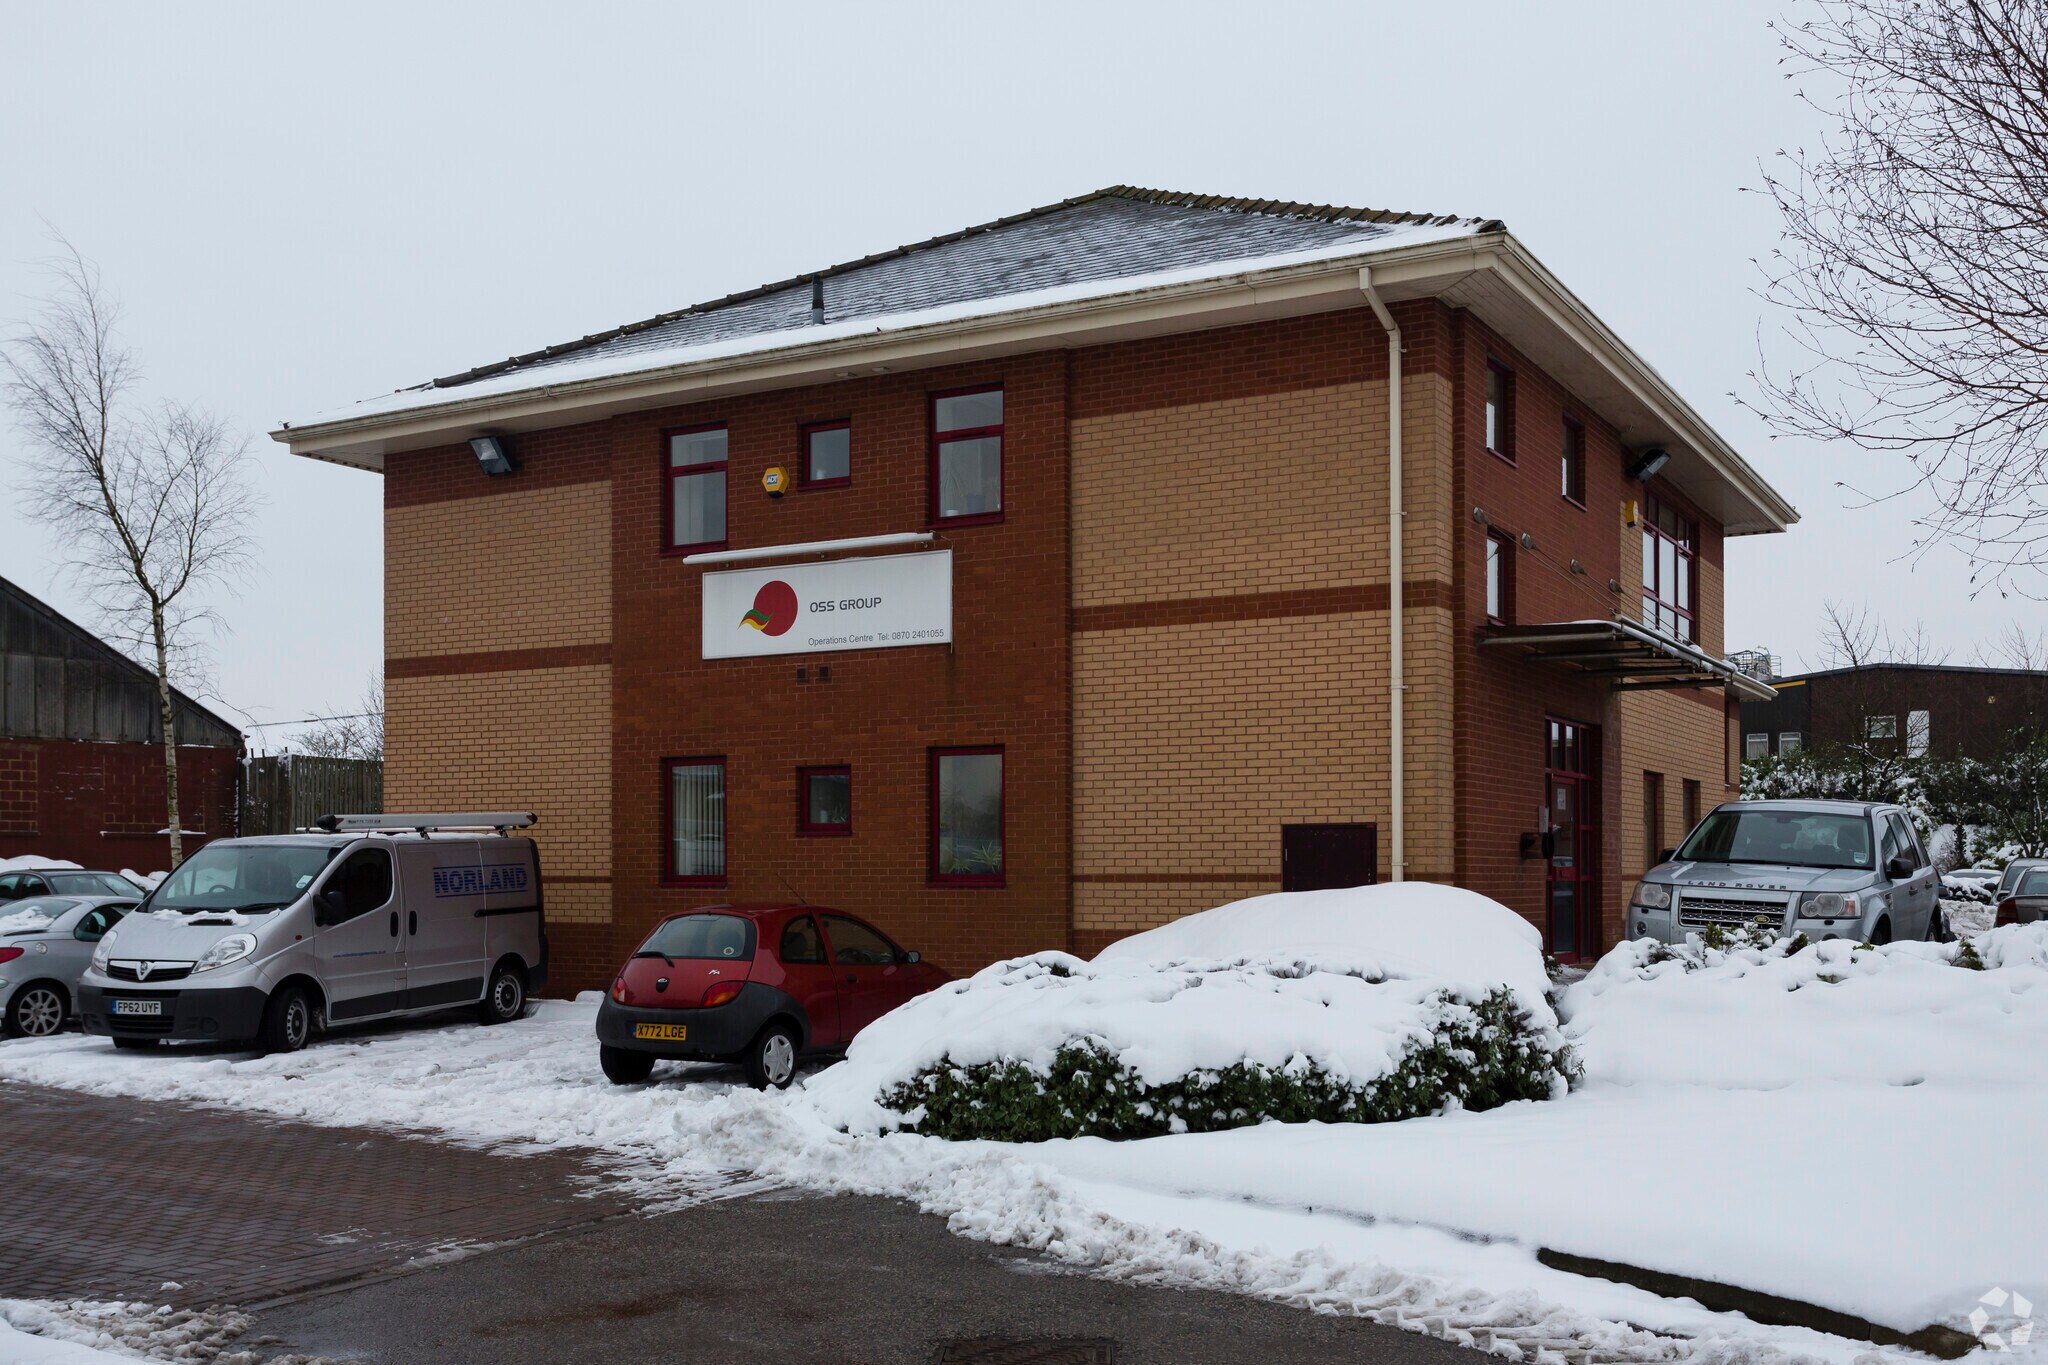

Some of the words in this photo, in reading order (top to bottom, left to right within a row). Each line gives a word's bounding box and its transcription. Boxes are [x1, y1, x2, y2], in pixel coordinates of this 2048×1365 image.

[809, 600, 835, 613] OSS
[839, 597, 882, 611] GROUP
[808, 635, 847, 647] Operations
[849, 634, 873, 643] Centre
[877, 632, 890, 641] Tel:
[892, 631, 910, 640] 0870
[912, 629, 944, 639] 2401055
[433, 867, 528, 894] NORLAND
[117, 1002, 140, 1013] FP62
[141, 1002, 160, 1013] UYF
[637, 1024, 662, 1037] X772
[664, 1026, 685, 1038] LGE
